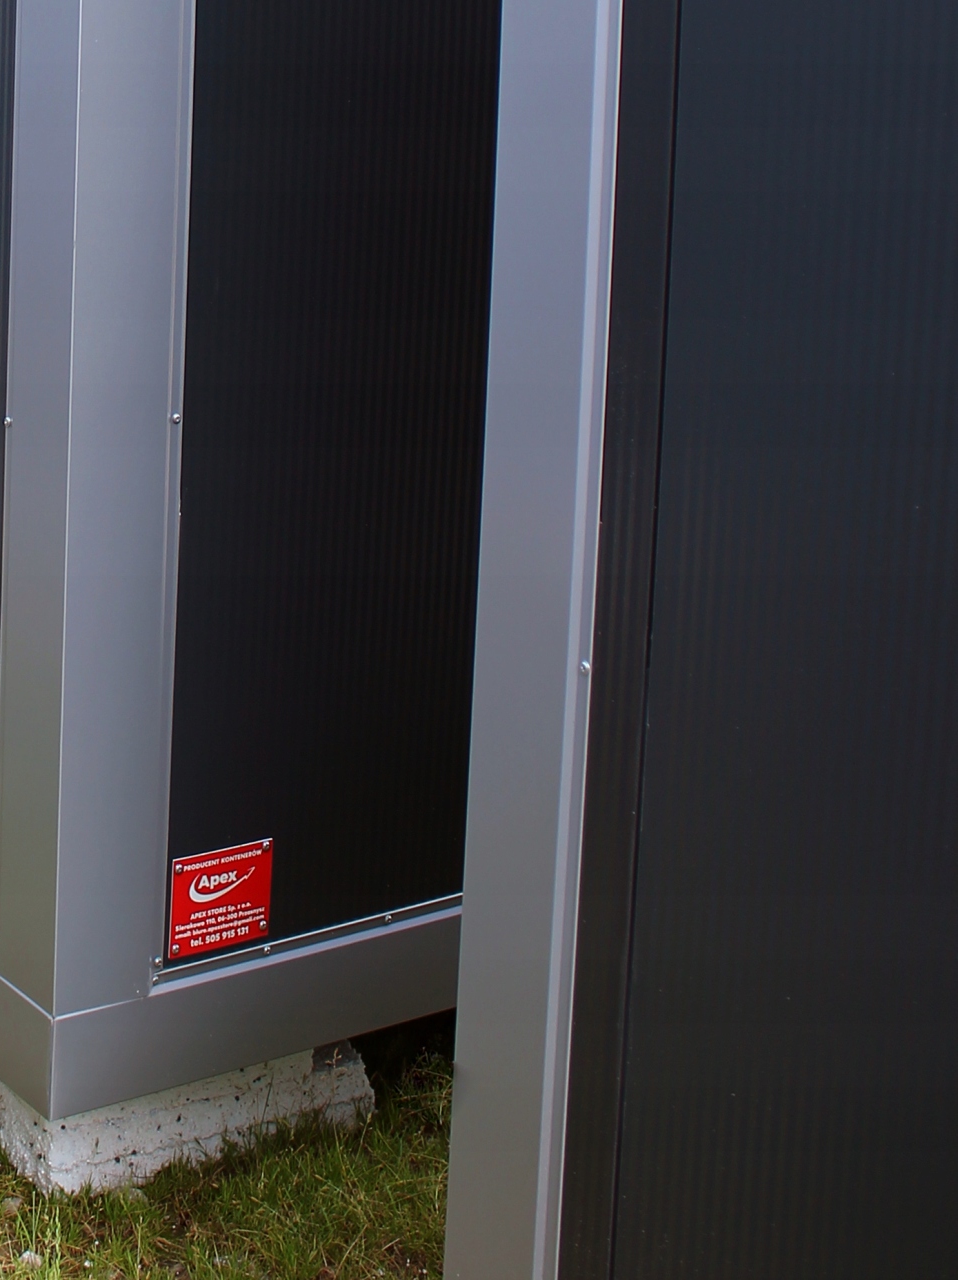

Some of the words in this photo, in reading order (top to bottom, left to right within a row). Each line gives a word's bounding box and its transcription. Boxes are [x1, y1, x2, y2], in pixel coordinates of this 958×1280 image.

[184, 859, 219, 872] PRODUCENT
[221, 849, 262, 864] KONTENERÓW
[198, 870, 238, 889] Apex
[190, 912, 206, 920] APEX
[207, 906, 227, 916] STORE
[218, 914, 237, 922] 06-300
[190, 937, 204, 947] tel.
[206, 933, 220, 944] 505
[222, 929, 235, 940] 915
[237, 926, 249, 935] 131
